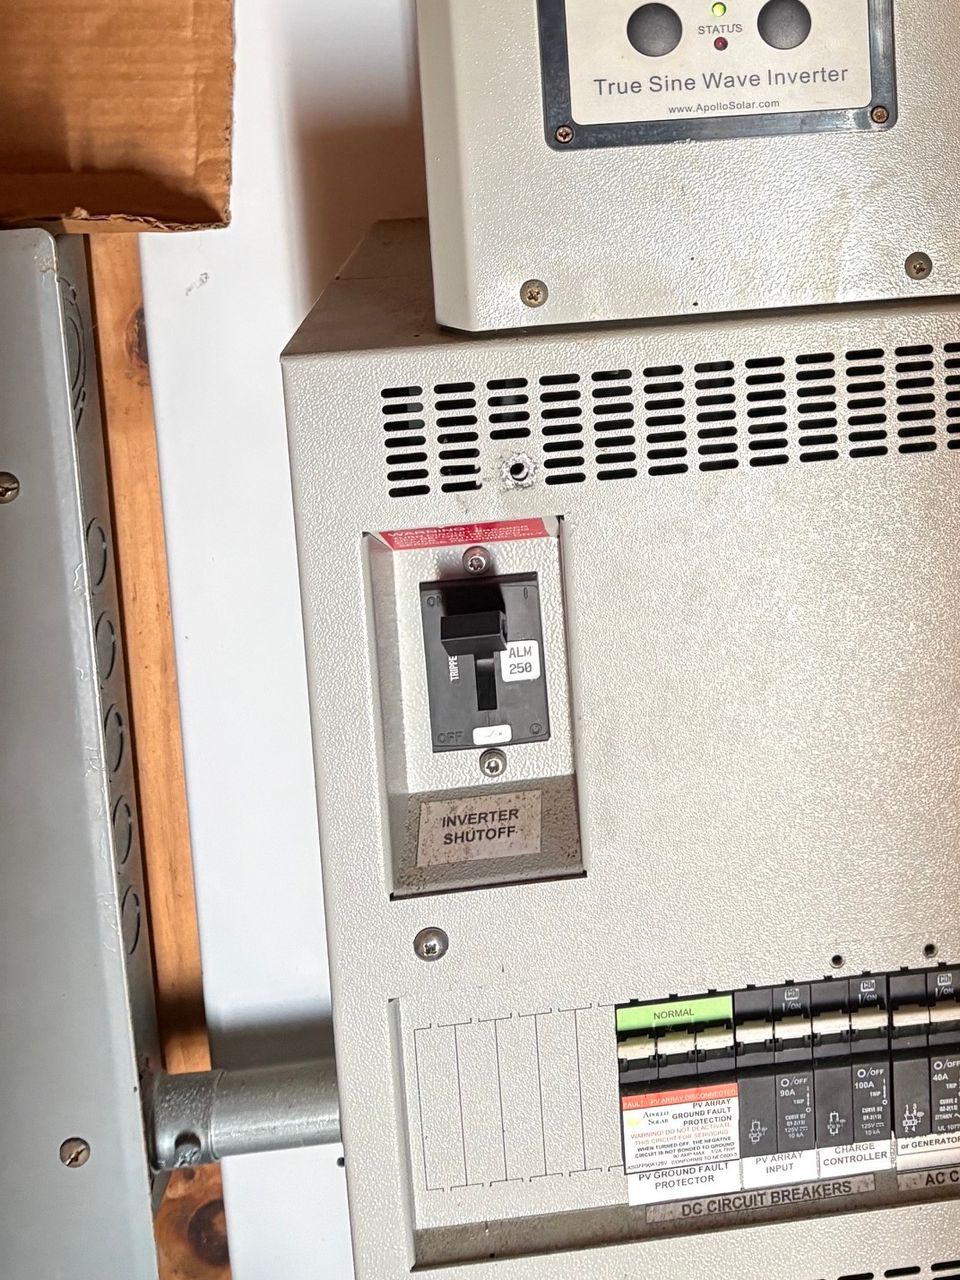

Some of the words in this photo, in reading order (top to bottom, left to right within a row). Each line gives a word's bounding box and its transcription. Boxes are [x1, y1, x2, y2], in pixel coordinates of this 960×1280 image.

[698, 23, 743, 35] STATUS
[593, 78, 643, 96] True
[649, 74, 696, 92] Sine
[702, 71, 761, 89] Wave
[768, 67, 848, 86] Inverter
[668, 99, 780, 114] www.ApolloSolar.com
[509, 647, 532, 658] ALM
[509, 662, 532, 674] 250
[437, 731, 463, 744] OFF
[441, 808, 519, 828] INVERTER
[443, 825, 516, 845] SHUTOFF
[653, 1007, 694, 1020] NORMAL
[933, 1073, 949, 1081] 40A
[854, 1081, 874, 1089] 100A
[705, 1099, 731, 1107] ARRAY
[672, 1111, 705, 1120] GROUND
[707, 1107, 732, 1116] FAULT
[683, 1115, 732, 1126] PROTECTION
[691, 1122, 732, 1132] DEACTIVATE
[704, 1136, 731, 1145] NEGATIVE
[710, 1141, 735, 1149] GROUND
[835, 1143, 875, 1155] CHARGE
[755, 1156, 768, 1165] PV
[770, 1151, 803, 1163] ARRAY
[823, 1151, 888, 1166] CONTROLLER
[638, 1173, 651, 1182] PV
[653, 1167, 697, 1180] GROUND
[699, 1162, 729, 1175] FAULT
[766, 1163, 794, 1174] INPUT
[655, 1175, 715, 1190] PROTECTOR
[925, 1170, 945, 1186] AC
[681, 1203, 703, 1217] DC
[707, 1193, 768, 1214] CIRCUIT
[771, 1181, 852, 1204] BREAKERS
